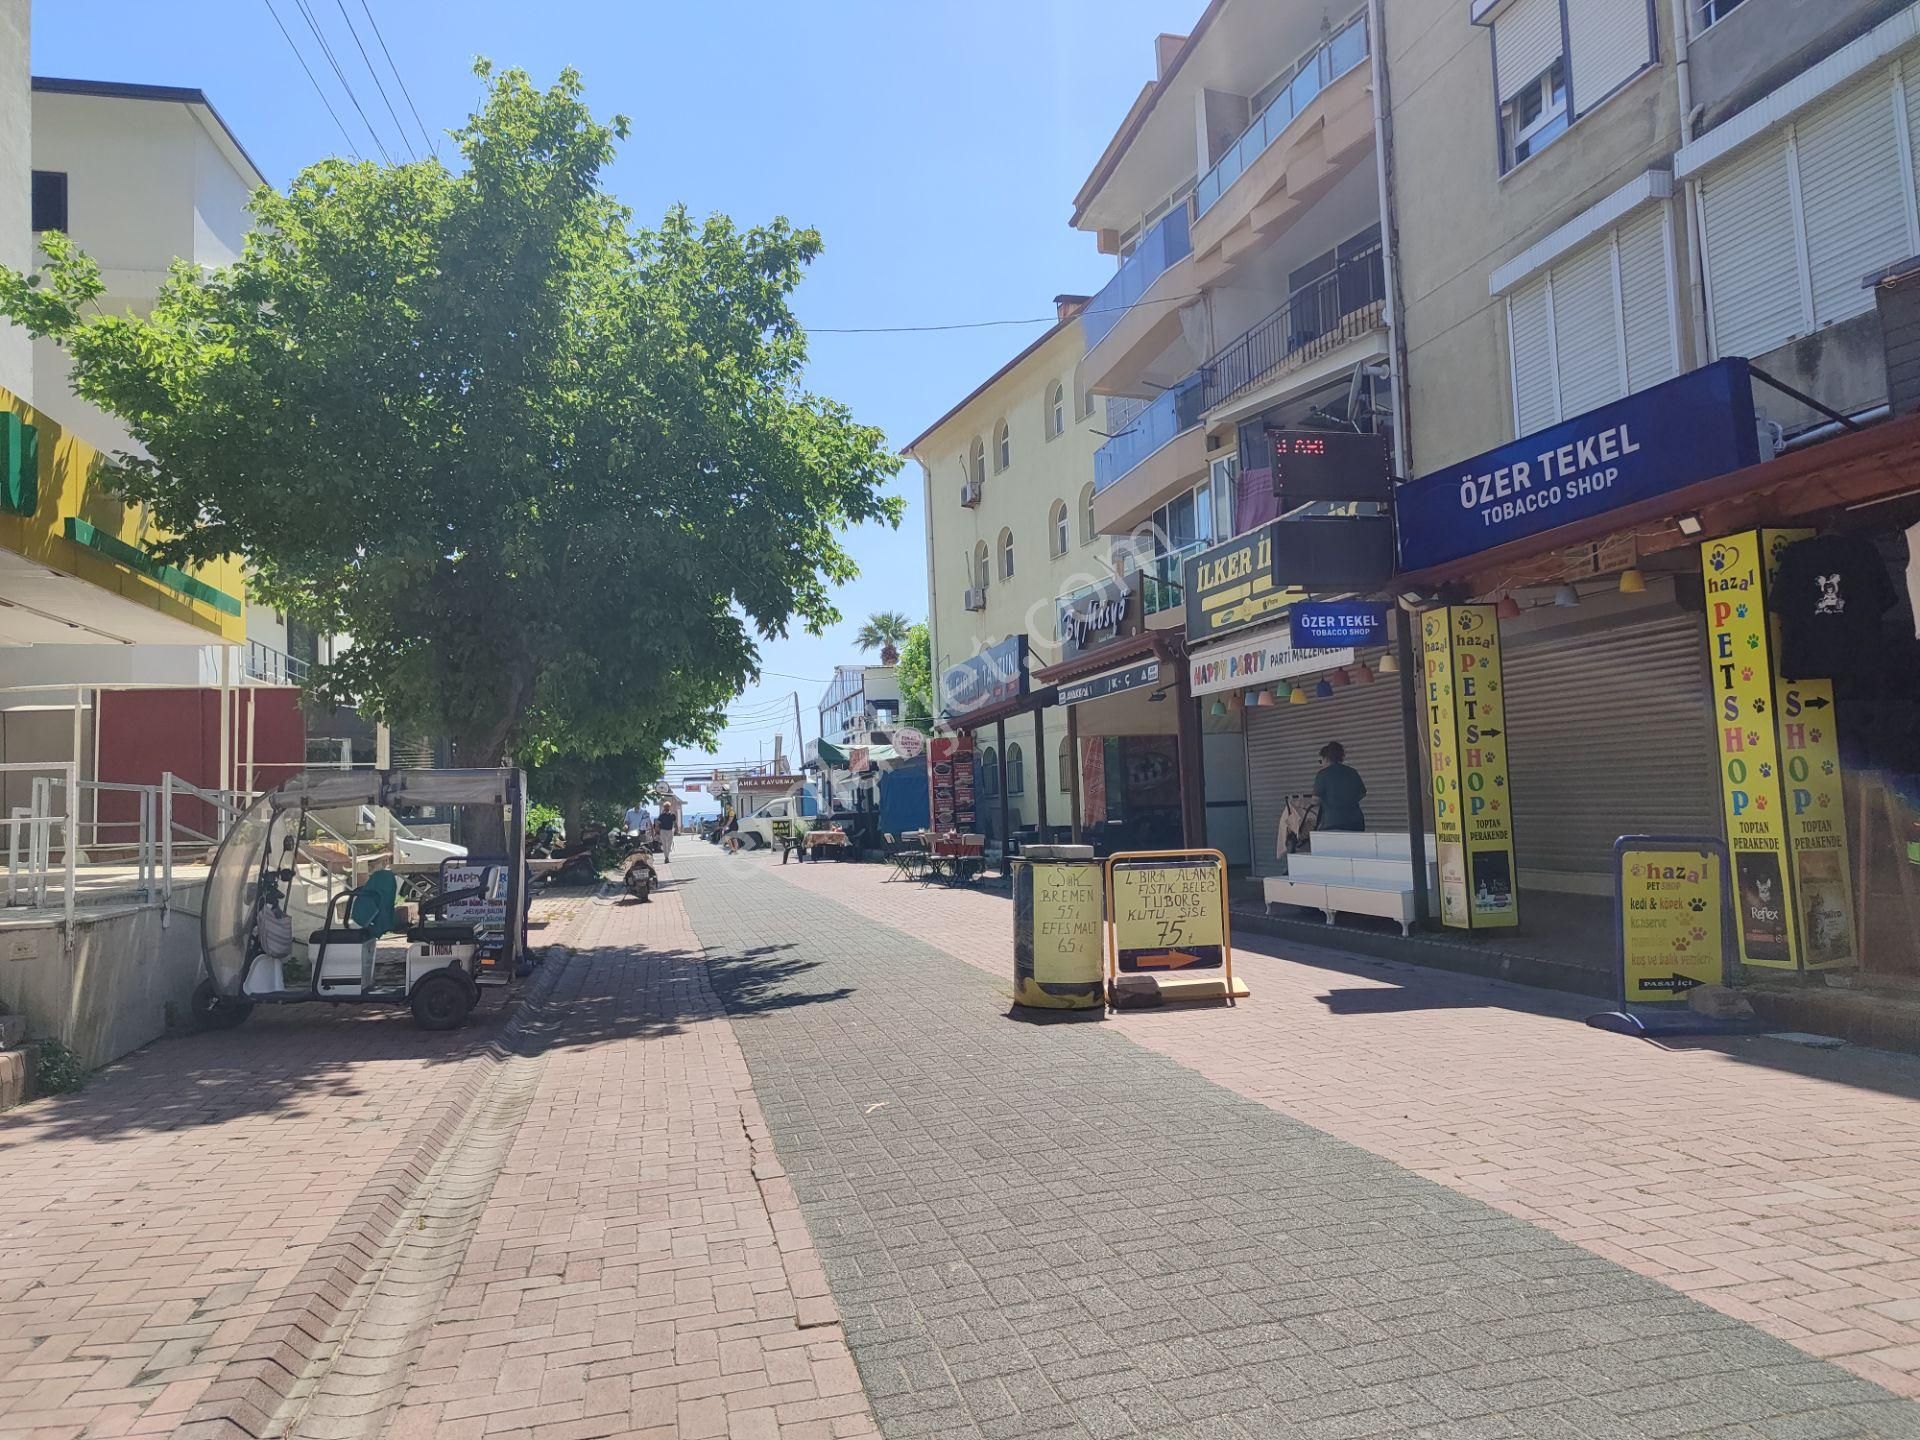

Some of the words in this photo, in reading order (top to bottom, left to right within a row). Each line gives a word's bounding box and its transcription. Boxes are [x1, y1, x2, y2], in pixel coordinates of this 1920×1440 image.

[1459, 461, 1533, 509] ÖZER
[1537, 423, 1641, 482] TEKEL
[1481, 486, 1562, 527] TOBACCO
[1566, 467, 1619, 499] SHOP
[1196, 546, 1253, 593] İLKER
[1707, 568, 1755, 594] hazal
[1301, 613, 1336, 628] ÖZER
[1337, 614, 1379, 627] TEKEL
[1311, 628, 1348, 637] TOBACCO
[1349, 628, 1371, 636] SHOP
[1424, 637, 1448, 654] hazal
[1456, 633, 1496, 649] hazal
[1193, 659, 1228, 686] HAPPY
[1230, 649, 1267, 678] PARTY
[1476, 819, 1501, 829] TOPTAN
[1738, 821, 1769, 834] TOPTAN
[1801, 819, 1833, 833] TOPTAN
[1469, 830, 1508, 841] PERAKENDE
[1733, 836, 1780, 850] PERAKENDE
[1794, 835, 1843, 850] PERAKENDE
[1139, 870, 1166, 884] BIRA
[1176, 867, 1216, 881] ALANA
[1646, 862, 1708, 885] hazal
[1138, 882, 1176, 896] FISTIK
[1646, 881, 1660, 891] PET
[1661, 881, 1681, 891] SHOP
[1040, 889, 1094, 903] BREMEN
[1140, 893, 1201, 909] TUBORG
[1630, 897, 1648, 910] kedi
[1649, 897, 1657, 910] &
[1751, 906, 1779, 922] Reflex
[1041, 921, 1071, 935] EFES
[1073, 921, 1097, 935] MALT
